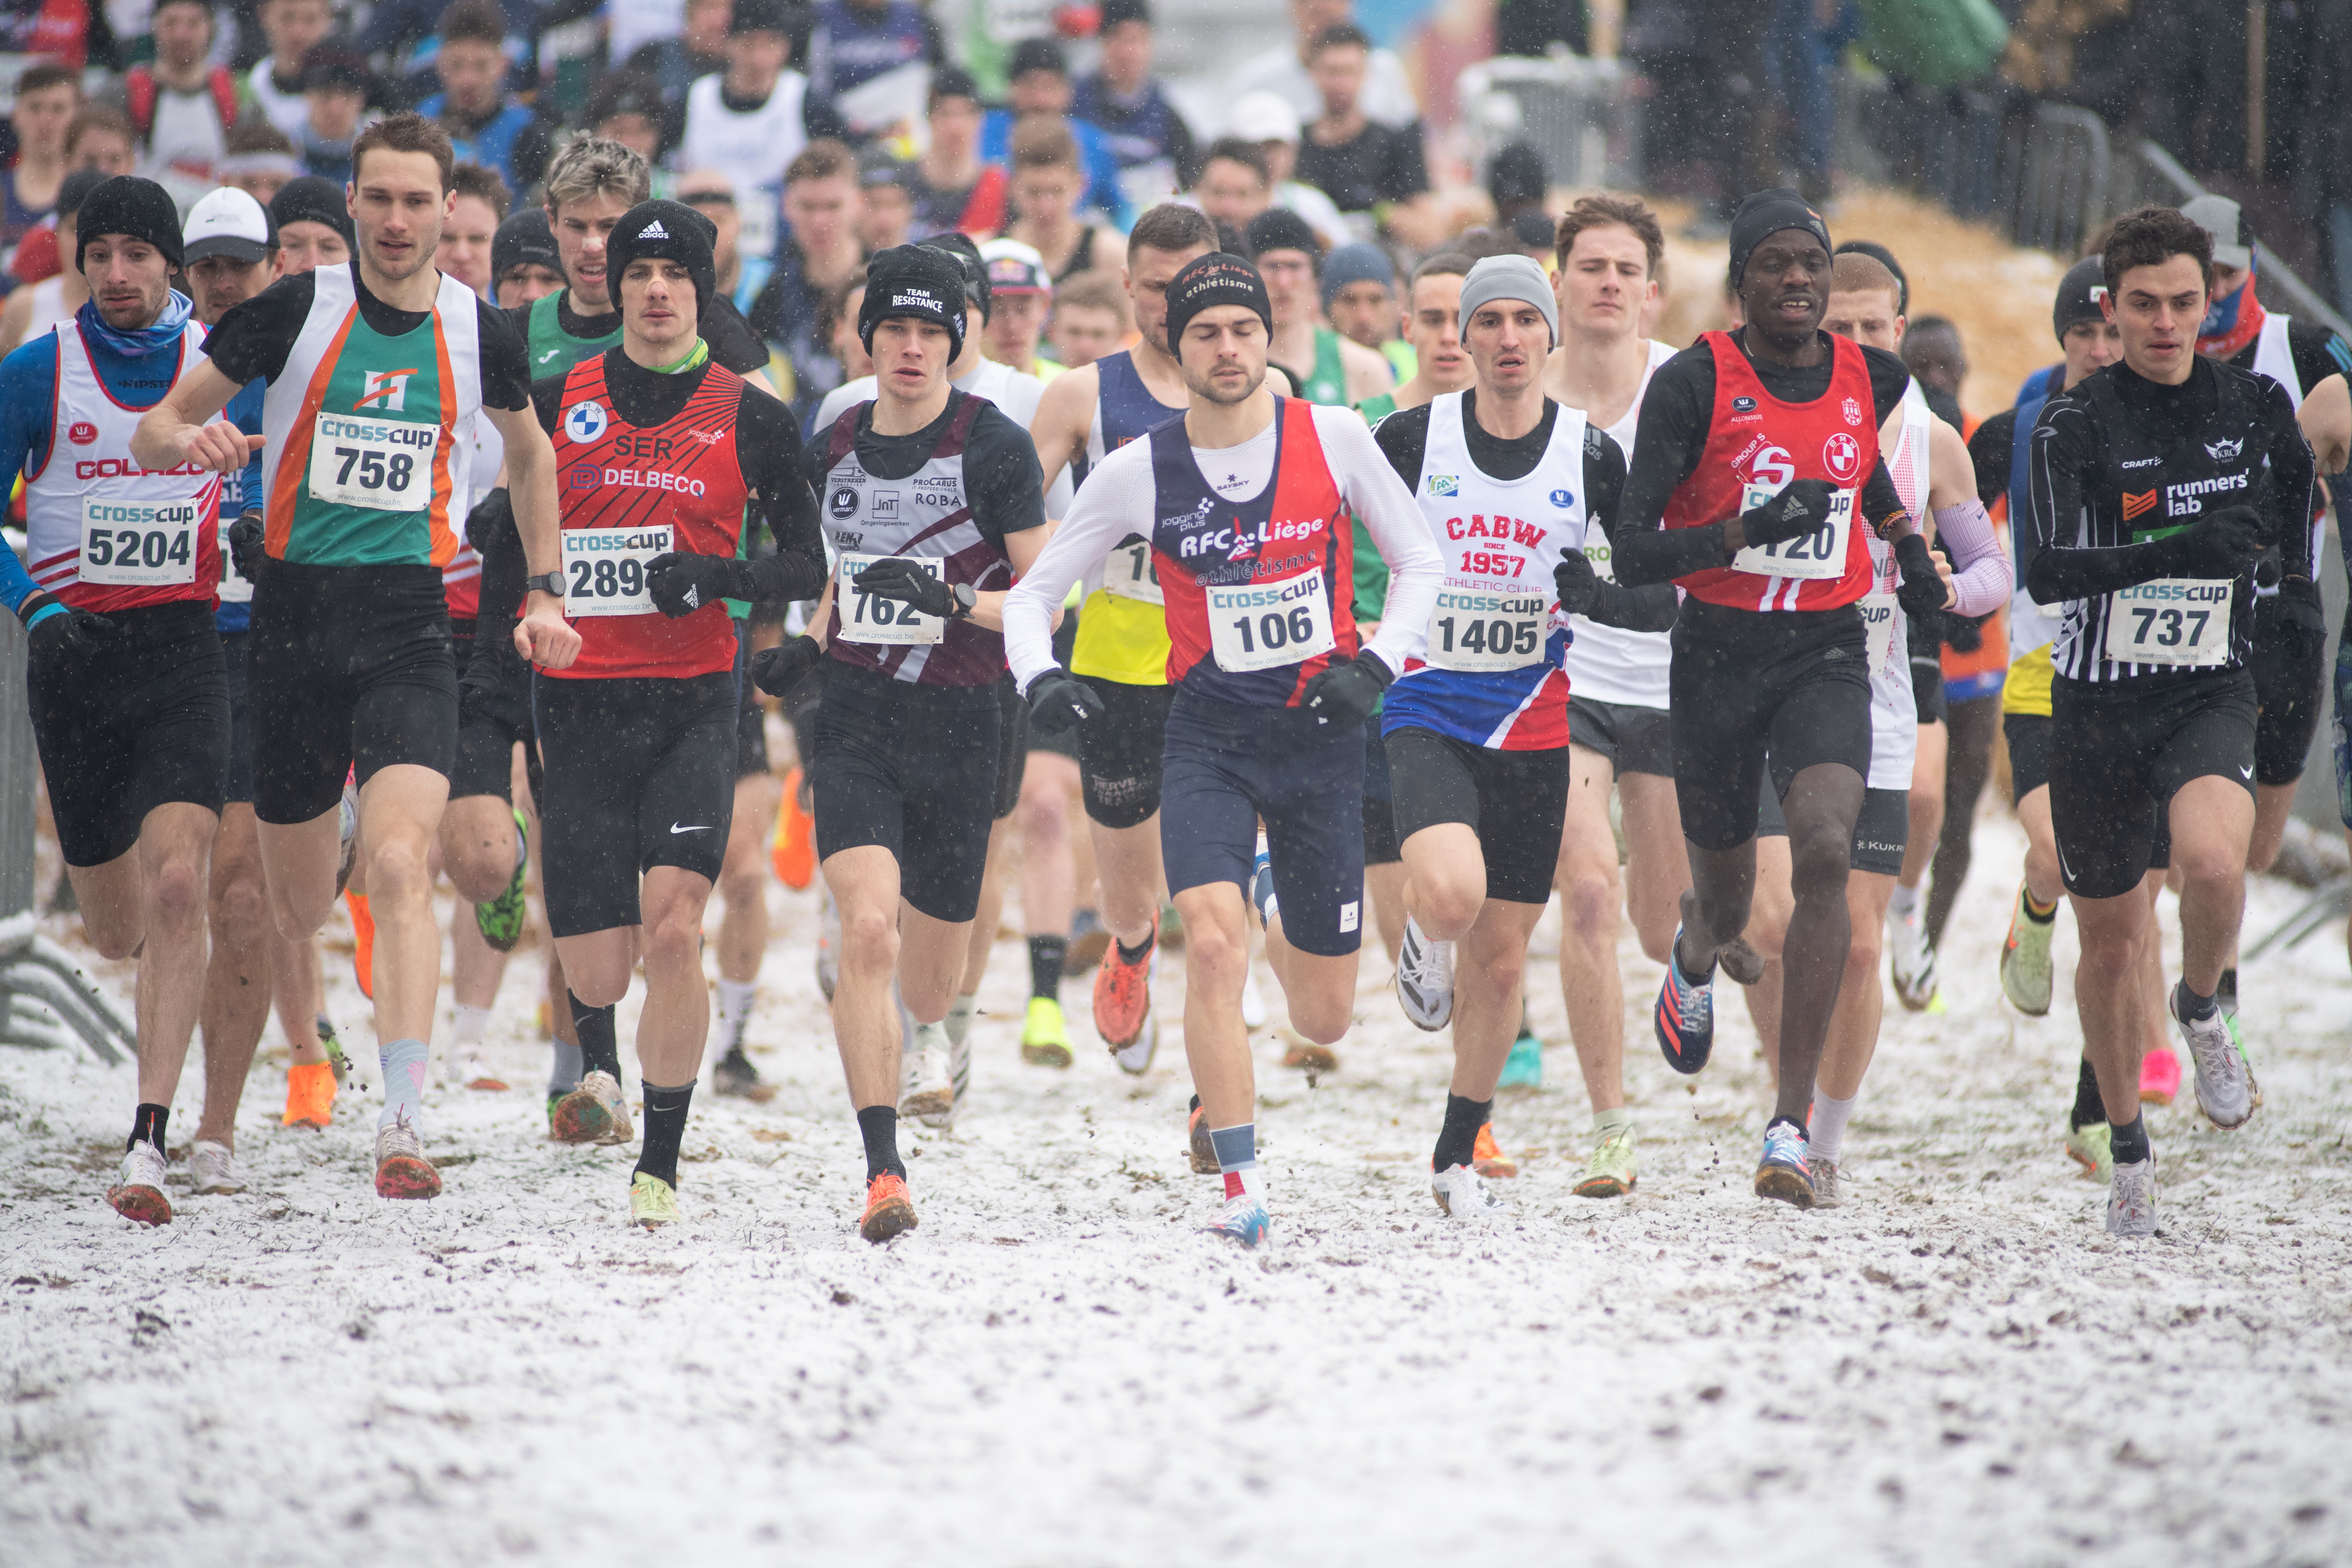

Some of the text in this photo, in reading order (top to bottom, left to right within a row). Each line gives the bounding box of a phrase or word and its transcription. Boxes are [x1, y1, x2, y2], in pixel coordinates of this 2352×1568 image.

[639, 231, 669, 240] adidas
[906, 288, 930, 299] TEAM
[1186, 277, 1254, 298] athlétisme
[892, 295, 943, 313] RESISTANCE
[1731, 413, 1763, 423] ALLONSIUS
[321, 420, 433, 450] crosscup
[688, 428, 717, 441] jogging
[613, 435, 674, 460] SER
[1731, 439, 1759, 469] GROUP
[1756, 432, 1766, 442] S
[2217, 448, 2237, 459] KRC
[335, 446, 413, 492] 758
[2122, 458, 2154, 469] CRAFT
[603, 468, 706, 500] DELBECQ
[1217, 479, 1250, 491] SAYSKY
[2166, 467, 2249, 498] runners'
[337, 492, 402, 507] www.crosscup.be
[915, 492, 962, 507] ROBA
[2167, 496, 2203, 518] lab
[89, 504, 194, 525] crosscup
[860, 519, 910, 528] Omgevingswerken
[1161, 510, 1205, 528] jogging
[1782, 508, 1809, 522] adidas
[1179, 519, 1207, 532] plus
[1446, 514, 1547, 550] CABW
[88, 528, 190, 568] 5204
[567, 532, 668, 551] crosscup
[1180, 518, 1324, 558] RFC Liège
[1483, 542, 1506, 550] SINCE
[1195, 549, 1316, 586] athlétisme
[1460, 550, 1526, 578] 1957
[1762, 564, 1826, 575] www.crosscup.be
[107, 573, 171, 583] www.crosscup.be
[570, 558, 651, 598] 289
[691, 583, 700, 609] adidas
[1213, 576, 1319, 609] crosscup
[2119, 584, 2228, 605] crosscup
[591, 603, 651, 612] www.crosscup.be
[851, 586, 921, 626] 762
[1436, 593, 1544, 616] crosscup
[855, 631, 914, 641] www.crosscup.be
[1233, 606, 1314, 653] 106
[1438, 616, 1537, 655] 1405
[2132, 607, 2211, 647] 737
[1245, 648, 1311, 668] www.crosscup.be
[2135, 652, 2200, 662] www.crosscup.be
[1868, 841, 1905, 852] KUKRI
